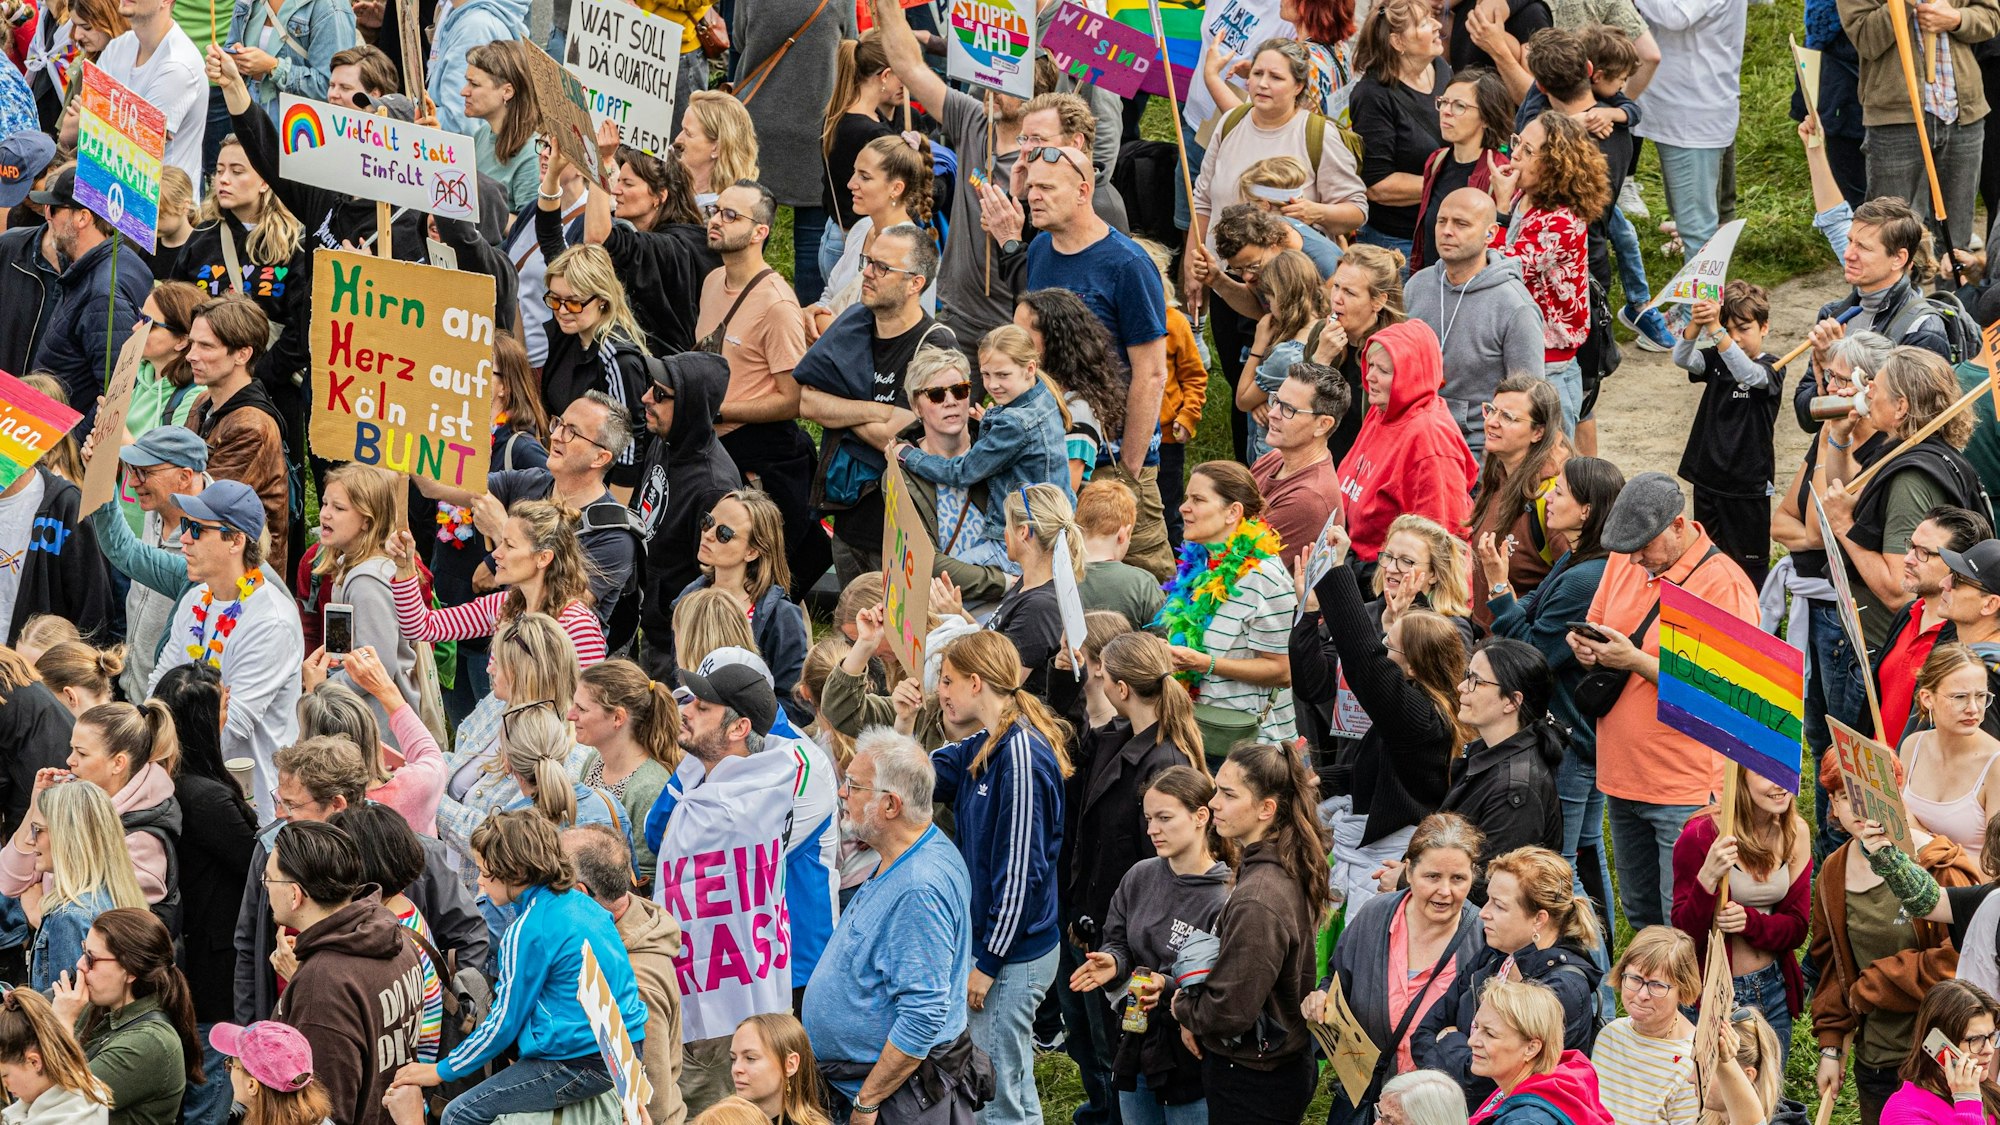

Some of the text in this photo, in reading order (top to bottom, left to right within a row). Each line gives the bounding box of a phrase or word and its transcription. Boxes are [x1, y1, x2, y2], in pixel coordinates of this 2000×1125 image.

[580, 1, 666, 63] WAT SOLL
[957, 0, 1022, 33] STOPPT
[973, 22, 1011, 56] AFD
[1057, 4, 1150, 73] WIR SIND
[588, 41, 610, 77] DÄ
[614, 52, 674, 106] QUATSCH.
[1045, 51, 1104, 85] UNT
[109, 88, 139, 141] FÜR
[582, 85, 632, 124] TOPPT
[331, 113, 457, 165] Vielfalt statt
[360, 152, 425, 187] Einfalt
[630, 126, 668, 159] AFD!
[330, 259, 493, 346] Hirn an
[327, 319, 492, 399] Herz auf
[326, 370, 474, 442] Köln ist
[1732, 390, 1751, 399] Dari
[353, 420, 477, 486] BUNT
[894, 526, 914, 591] nie
[1660, 618, 1796, 740] Toleranz
[1832, 725, 1899, 801] EKEL
[662, 838, 780, 923] KEIN
[671, 895, 793, 996] RASS
[1170, 918, 1205, 937] HEA
[378, 979, 406, 1029] DO
